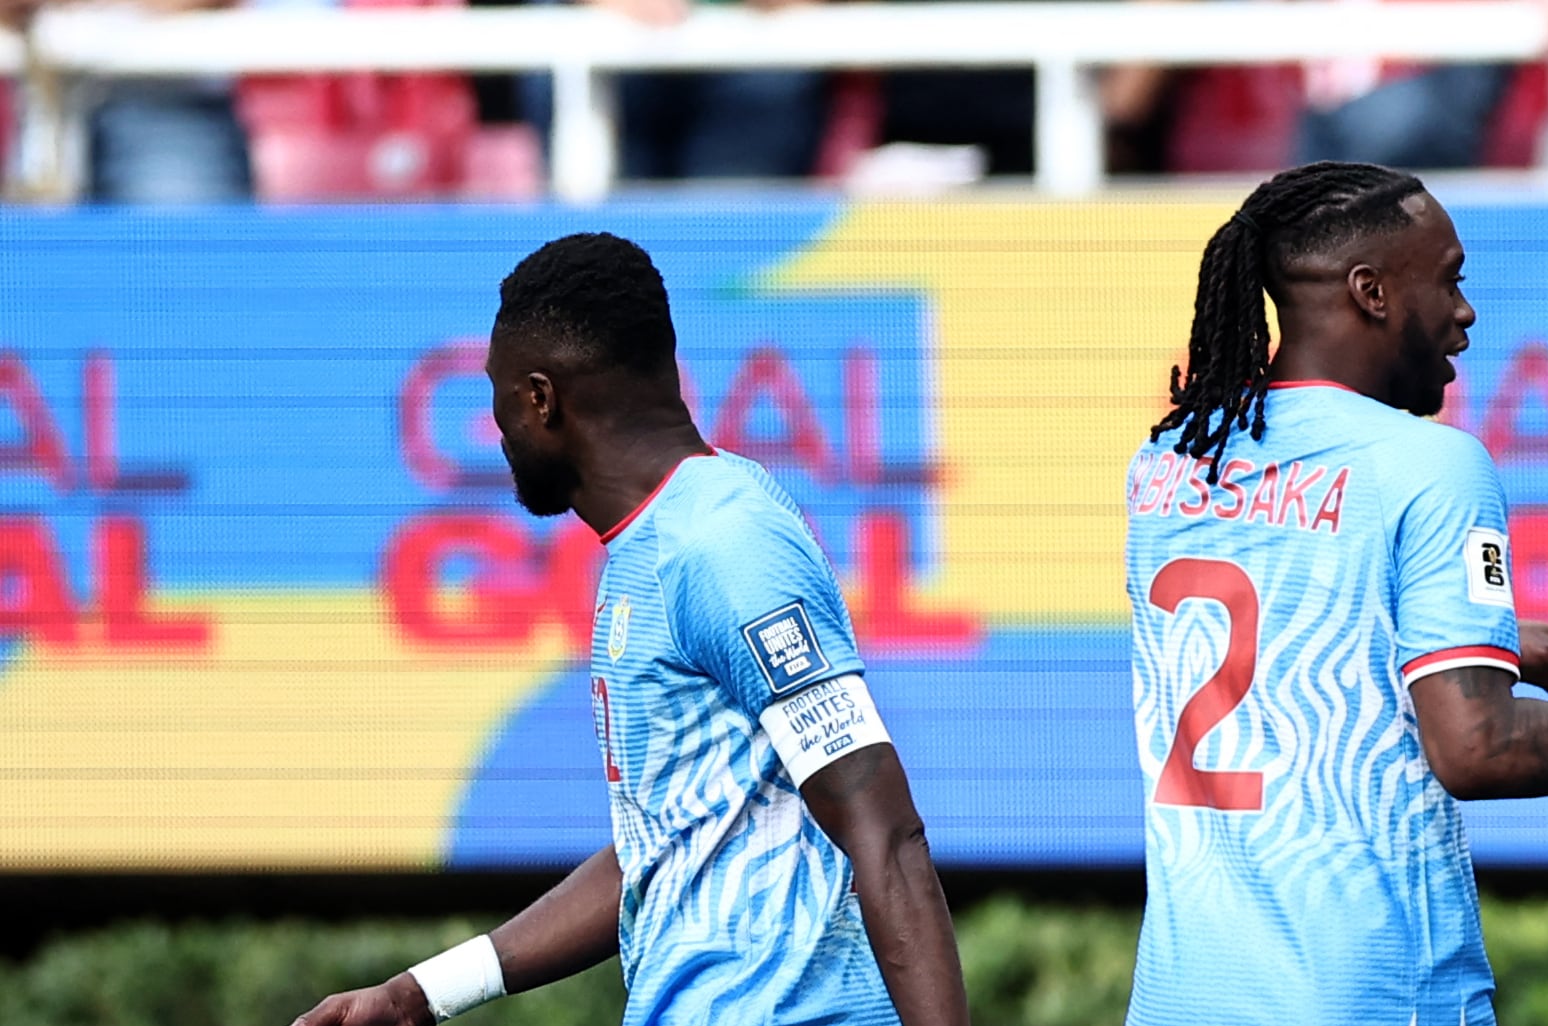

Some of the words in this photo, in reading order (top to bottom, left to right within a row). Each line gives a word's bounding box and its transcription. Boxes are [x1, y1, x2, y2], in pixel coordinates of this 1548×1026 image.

[402, 340, 954, 488] GAL
[382, 510, 982, 645] GL
[758, 616, 798, 642] FOOTBALL
[763, 627, 803, 655] UNITES
[769, 653, 786, 668] the
[783, 640, 810, 662] World
[782, 679, 847, 718] FOOTBALL
[1149, 557, 1263, 811] 2
[789, 691, 855, 735] UNITES
[800, 734, 822, 752] the
[821, 710, 866, 739] World
[823, 734, 854, 756] FIFA
